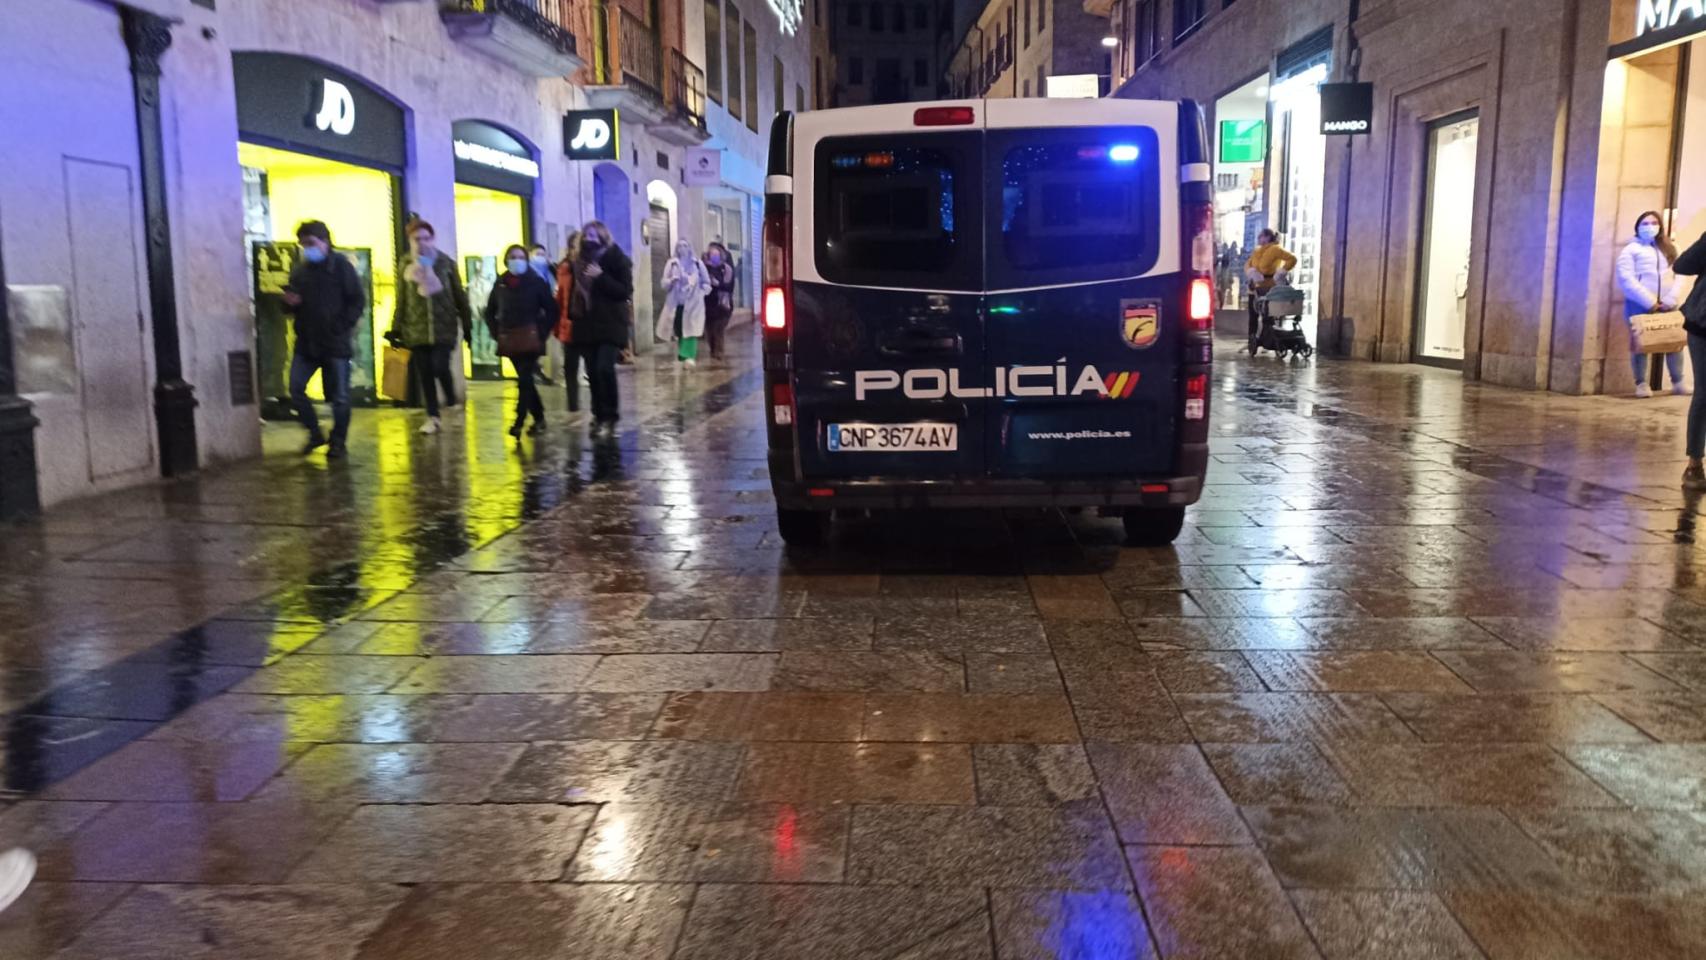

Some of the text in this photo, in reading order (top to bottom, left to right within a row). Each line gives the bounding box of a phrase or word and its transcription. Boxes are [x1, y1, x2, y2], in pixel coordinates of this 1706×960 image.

[1636, 0, 1706, 36] MA
[316, 78, 355, 135] JD
[571, 118, 610, 149] JD
[1324, 120, 1368, 131] MANGO
[855, 356, 1109, 400] POLICÍA
[1028, 430, 1132, 440] www.policia.es
